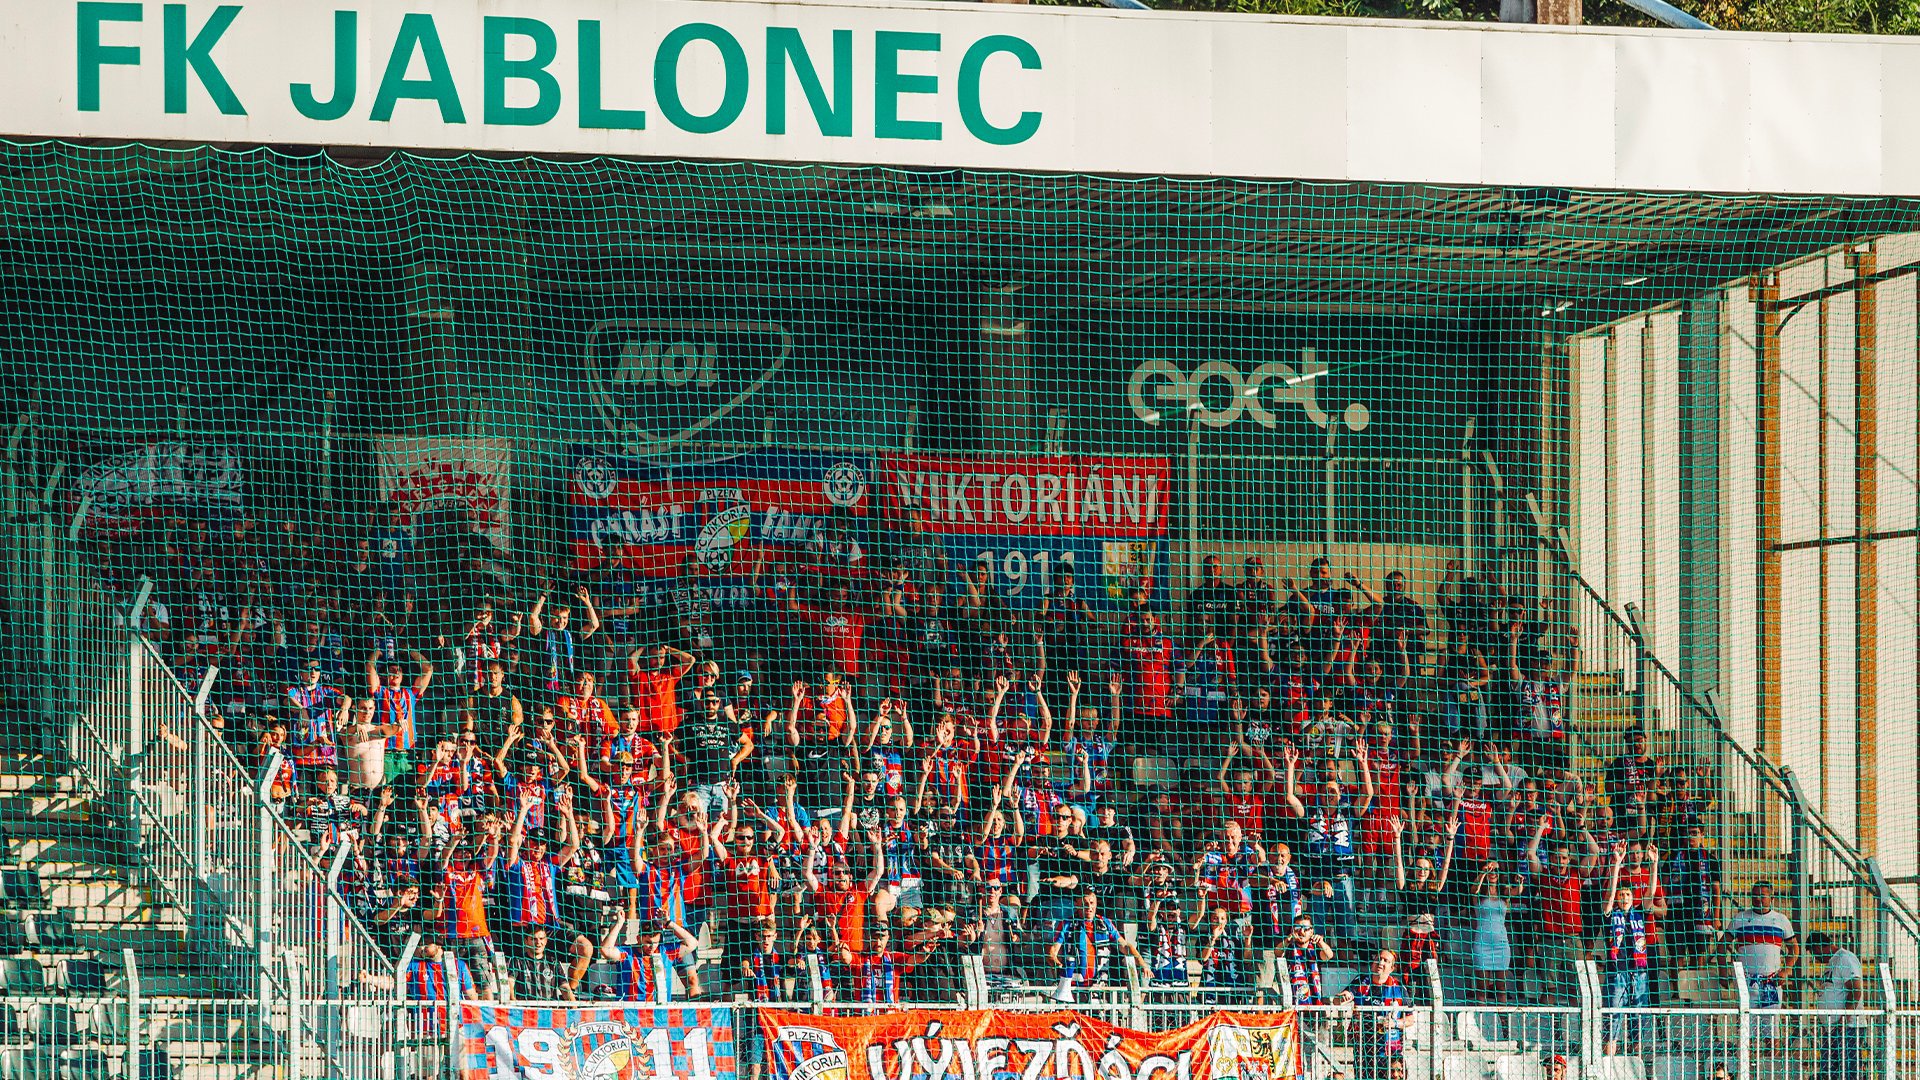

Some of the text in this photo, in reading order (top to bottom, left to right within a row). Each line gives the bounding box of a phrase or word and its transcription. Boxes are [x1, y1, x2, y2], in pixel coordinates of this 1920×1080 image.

[77, 2, 1043, 146] FK JABLONEC
[613, 340, 721, 387] MOL
[898, 463, 1159, 524] VIKTORIÁNI
[588, 1040, 628, 1065] VIKTORIA
[643, 1027, 718, 1080] 11
[795, 1055, 843, 1080] IKTORIA
